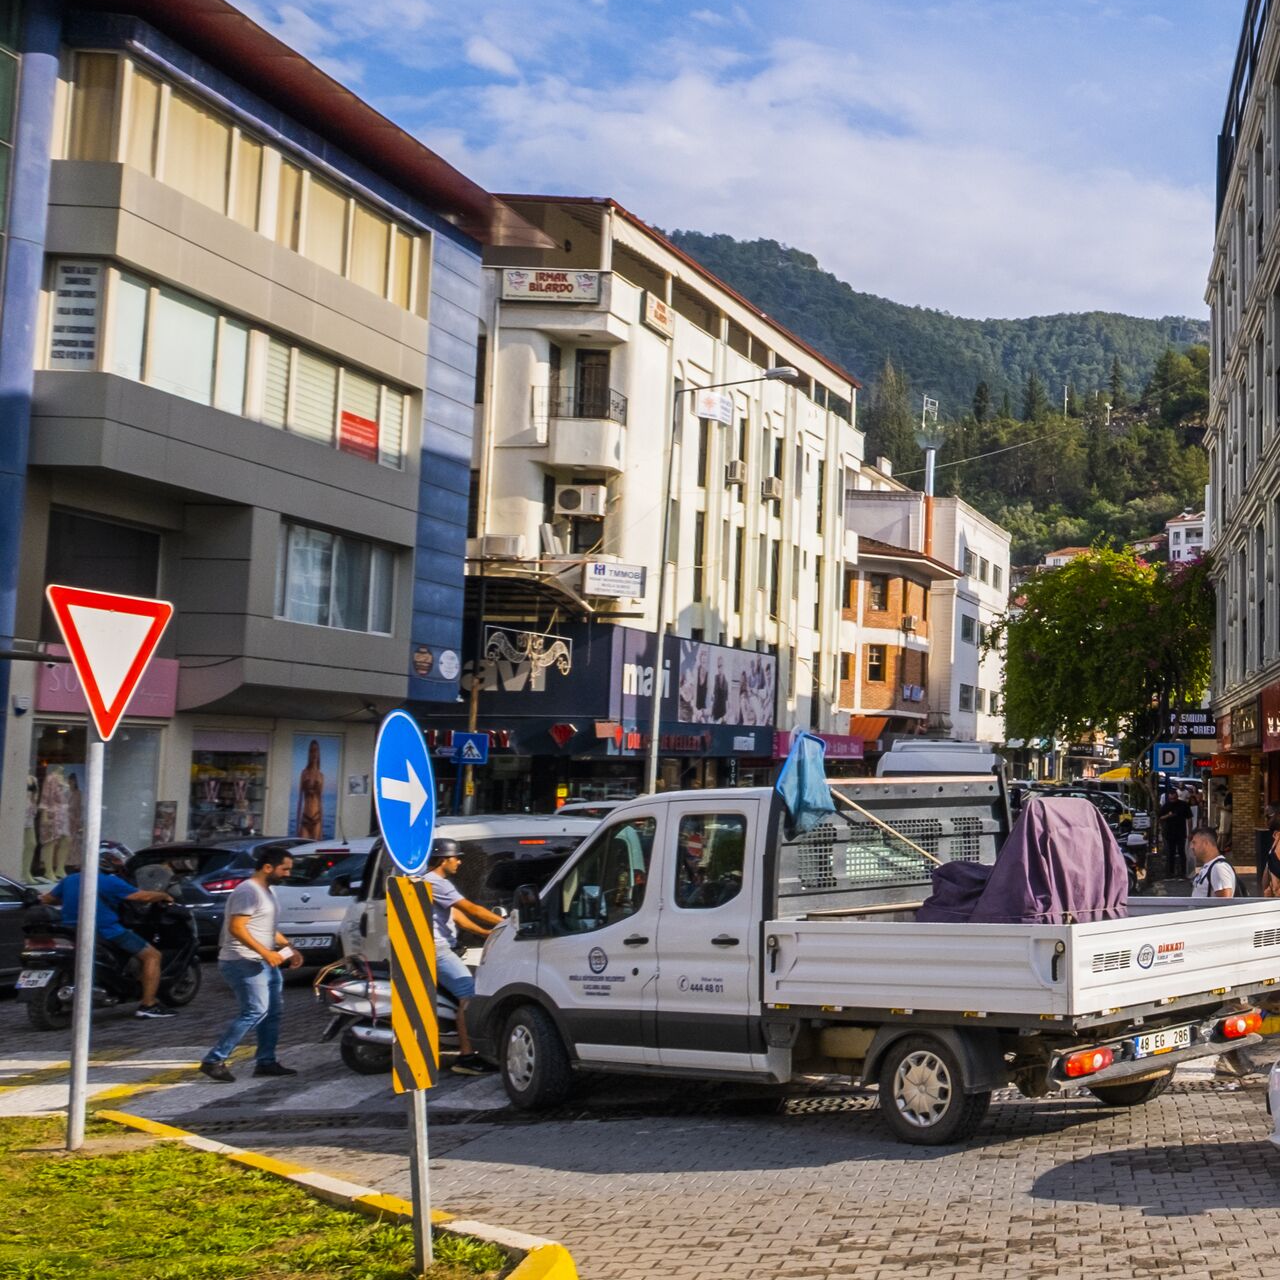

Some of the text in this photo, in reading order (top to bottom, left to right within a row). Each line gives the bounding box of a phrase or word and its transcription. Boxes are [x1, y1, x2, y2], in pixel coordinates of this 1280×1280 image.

[623, 660, 671, 698] mai
[1171, 714, 1206, 723] PEMIUM
[1162, 750, 1175, 765] D
[690, 983, 724, 993] 444 48 01
[1140, 1029, 1188, 1050] 48 EG 286
